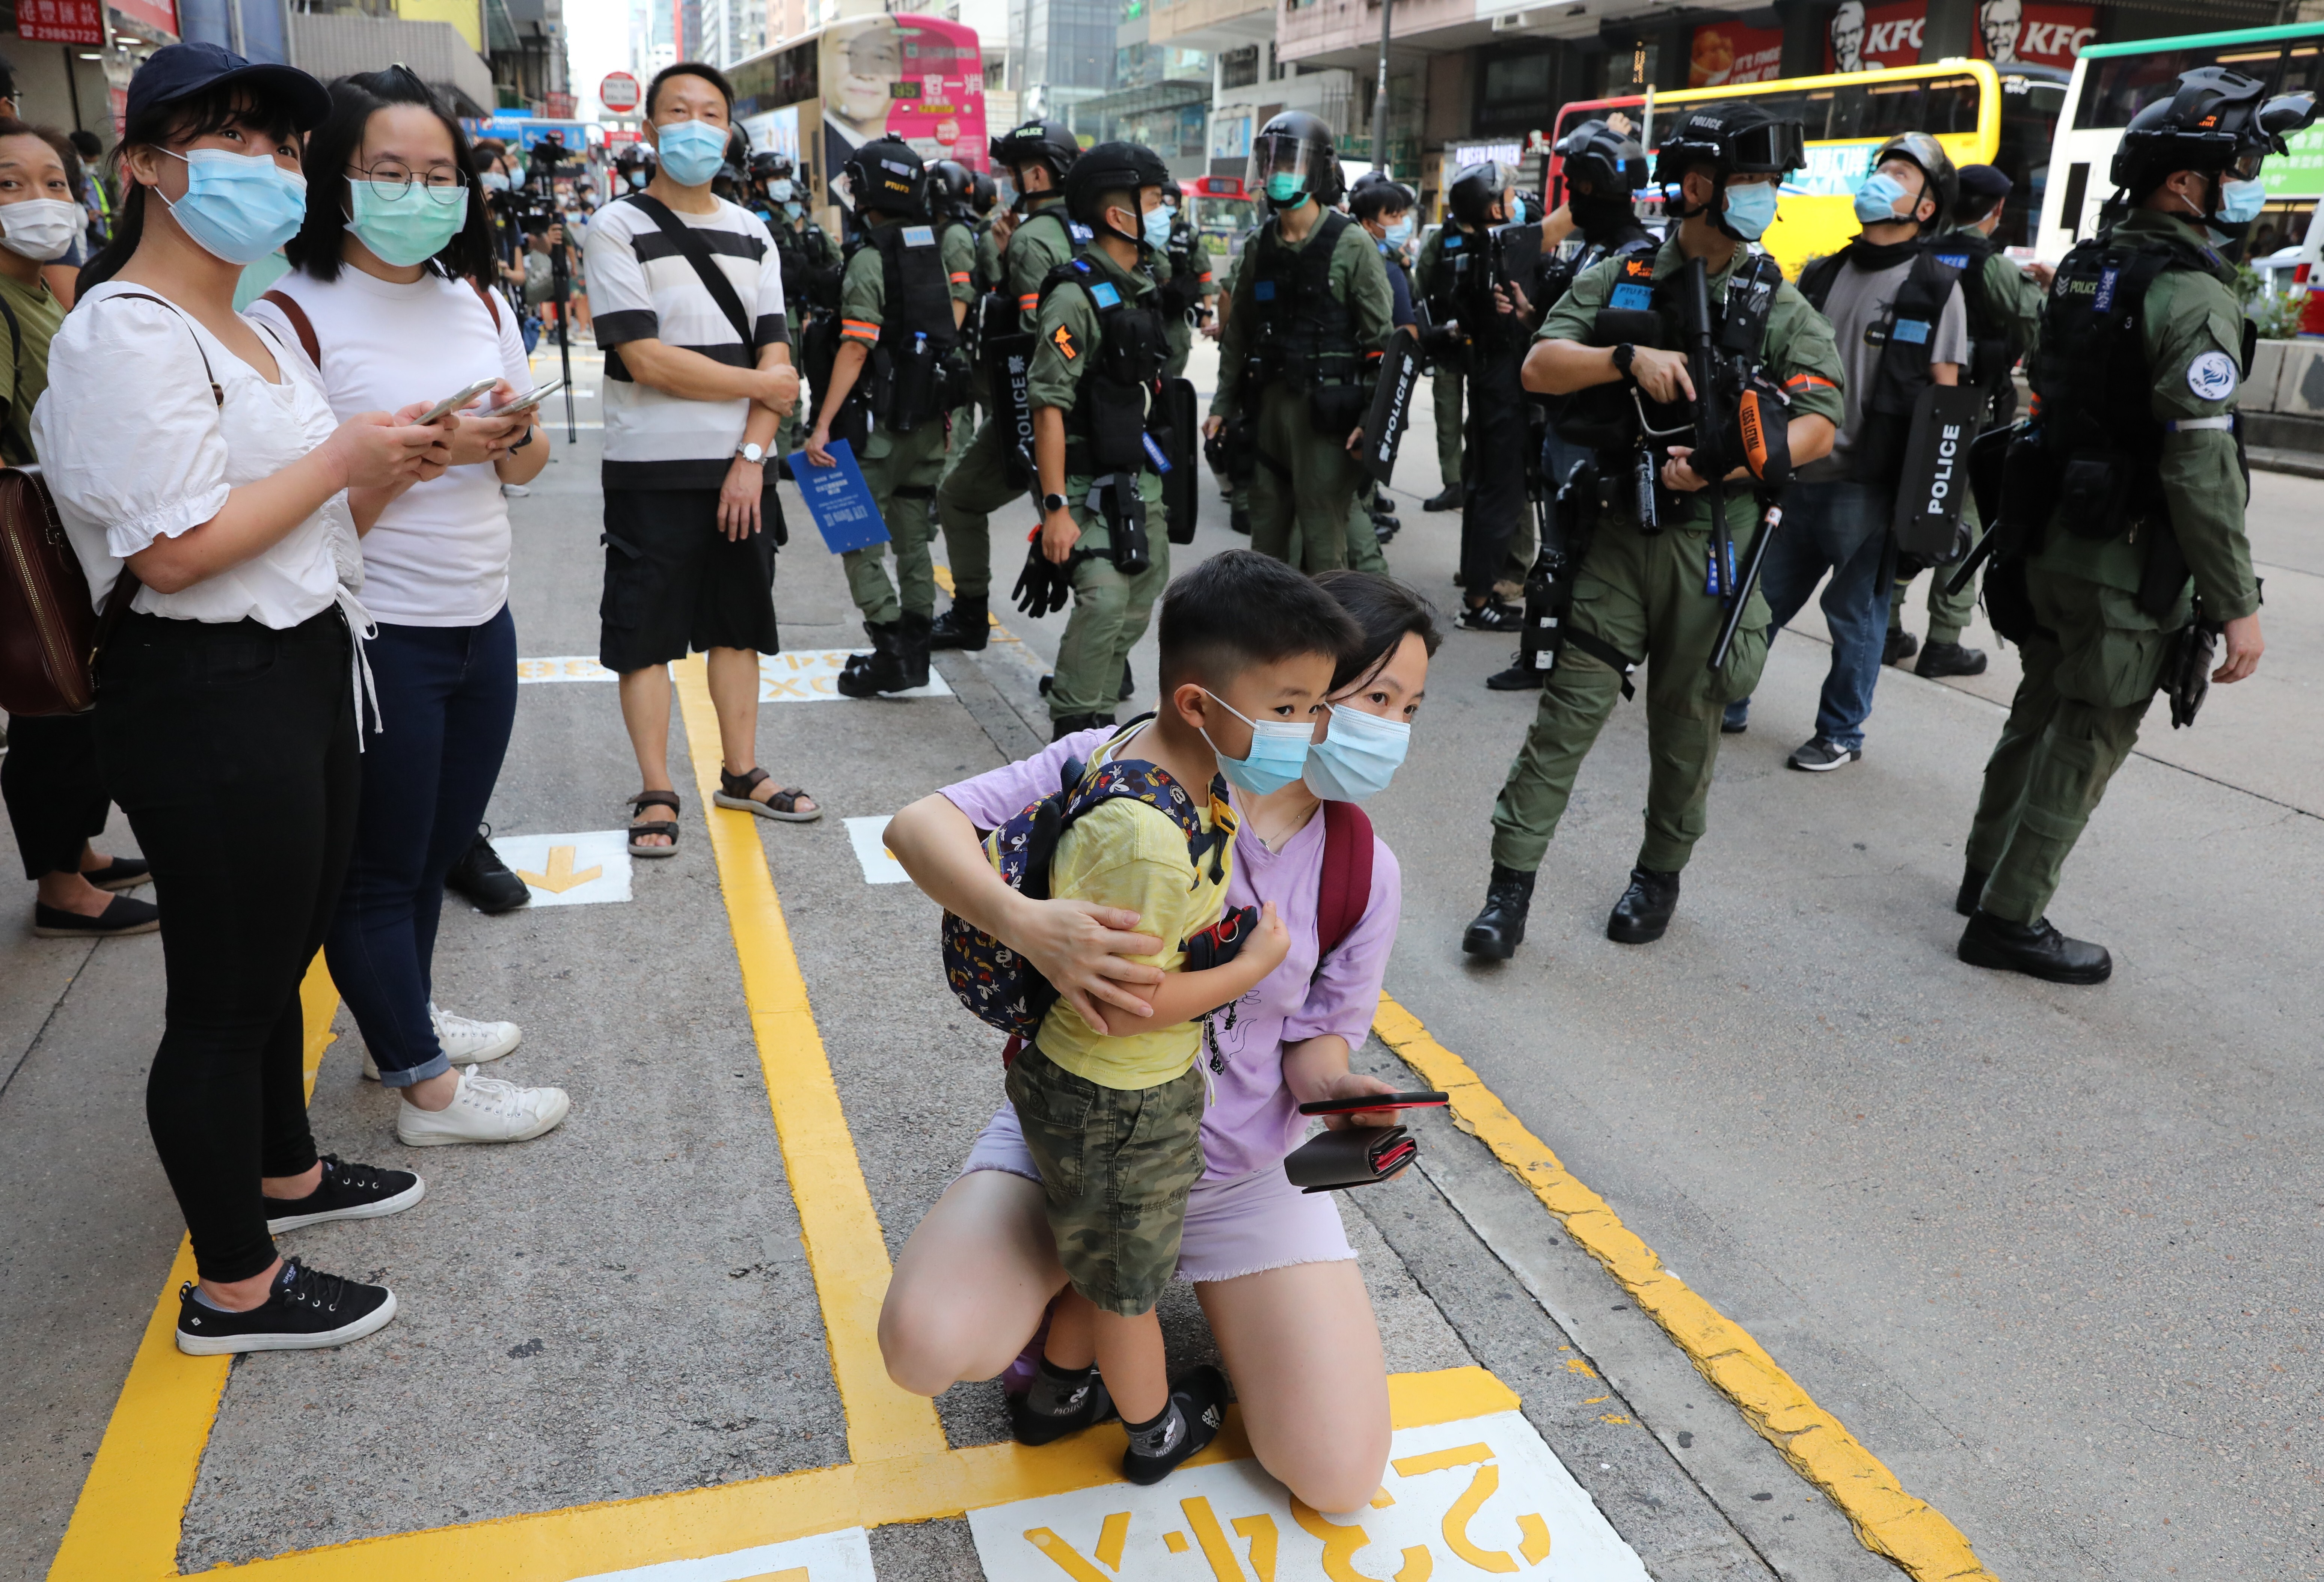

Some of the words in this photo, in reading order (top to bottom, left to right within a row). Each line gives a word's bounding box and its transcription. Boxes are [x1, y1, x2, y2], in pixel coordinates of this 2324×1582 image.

[1864, 17, 1926, 54] KFC
[2020, 21, 2098, 57] KFC
[1015, 127, 1043, 138] POLICE
[1690, 116, 1723, 130] POLICE
[2070, 280, 2098, 295] POLICE
[1384, 374, 1409, 443] POLICE
[1742, 405, 1755, 426] LESS
[1744, 424, 1760, 453] LETHAL
[1927, 424, 1960, 514] POLICE
